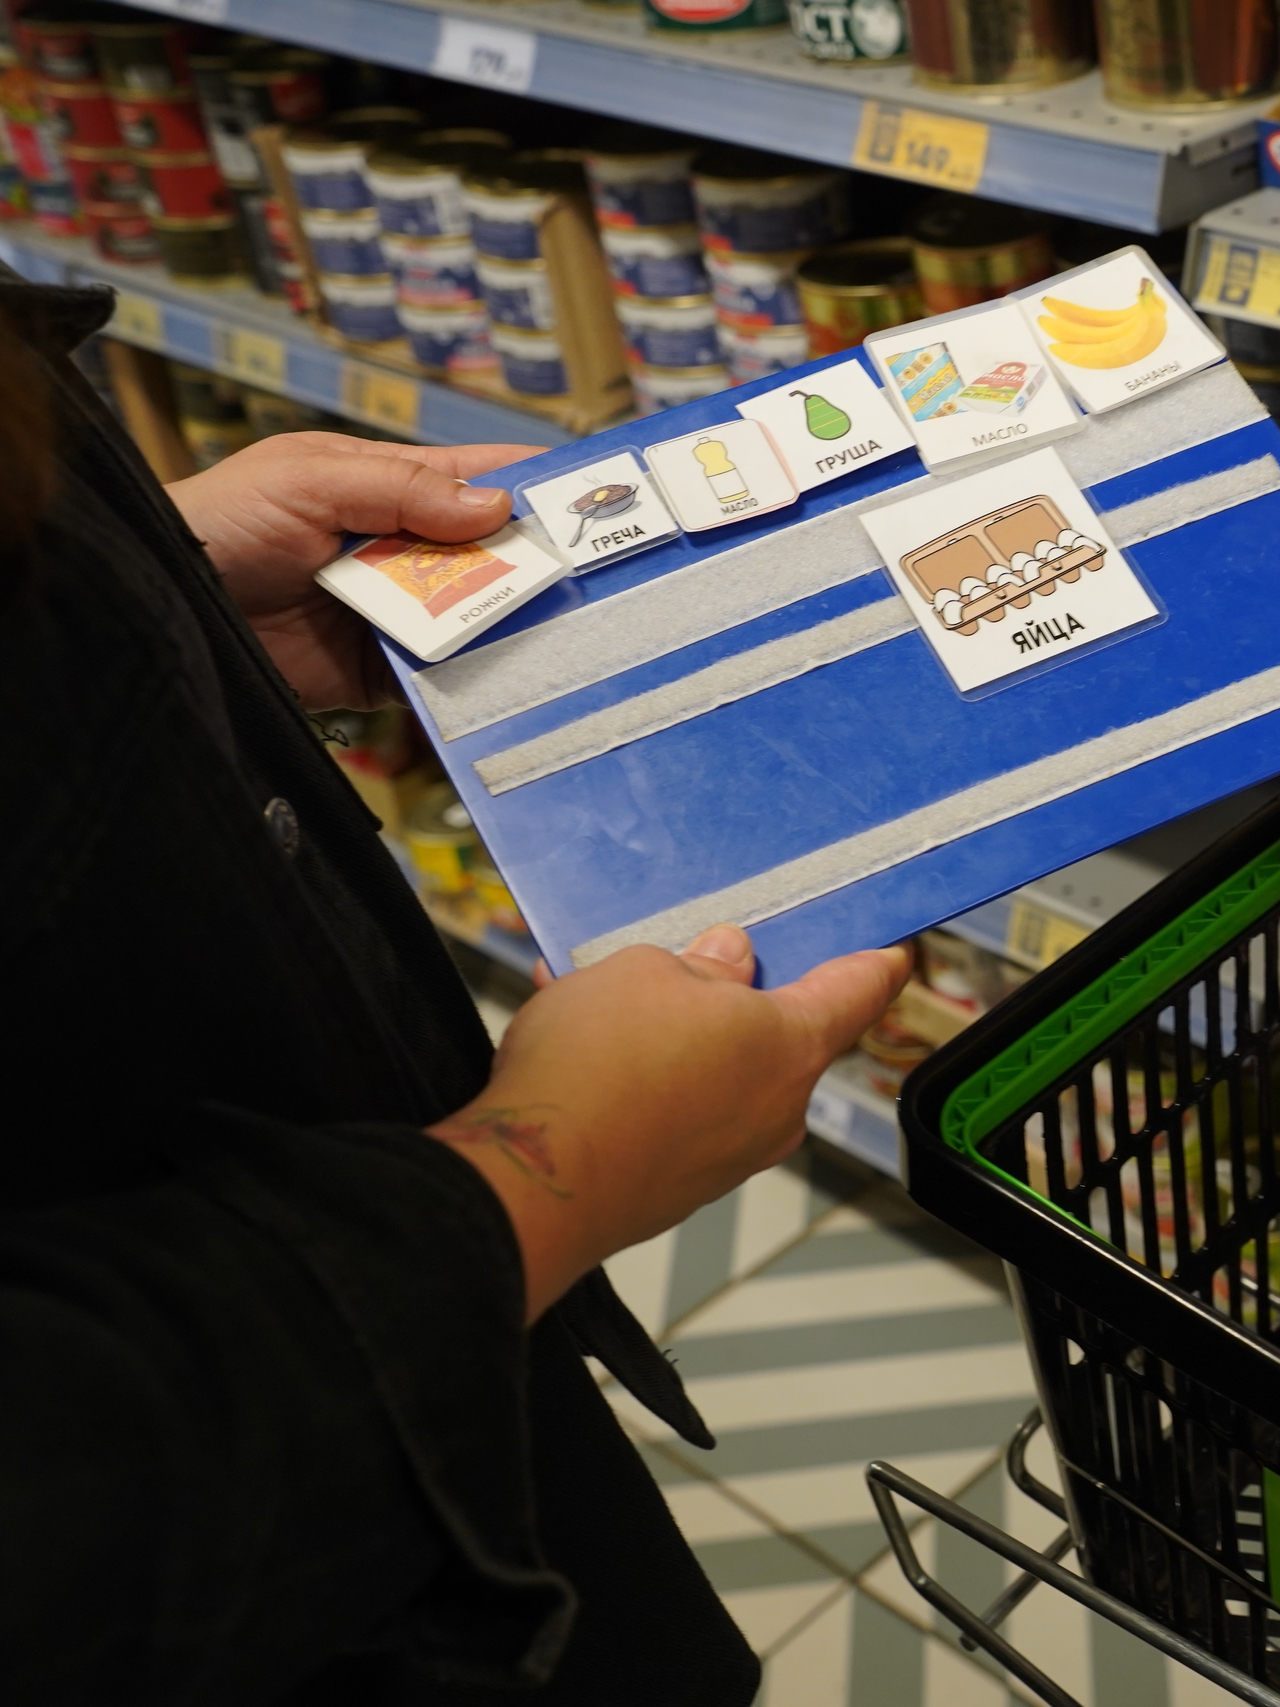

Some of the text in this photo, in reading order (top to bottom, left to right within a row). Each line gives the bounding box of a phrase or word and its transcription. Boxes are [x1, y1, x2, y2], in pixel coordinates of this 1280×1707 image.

[1124, 360, 1182, 392] БАНАНЫ
[971, 423, 1029, 447] МАСЛО
[815, 439, 883, 474] ГРУША
[720, 497, 759, 516] МАСЛО
[590, 524, 647, 553] ГРЕЧА
[459, 586, 516, 624] РОЖКИ
[1011, 612, 1086, 654] ЯЙЦА
